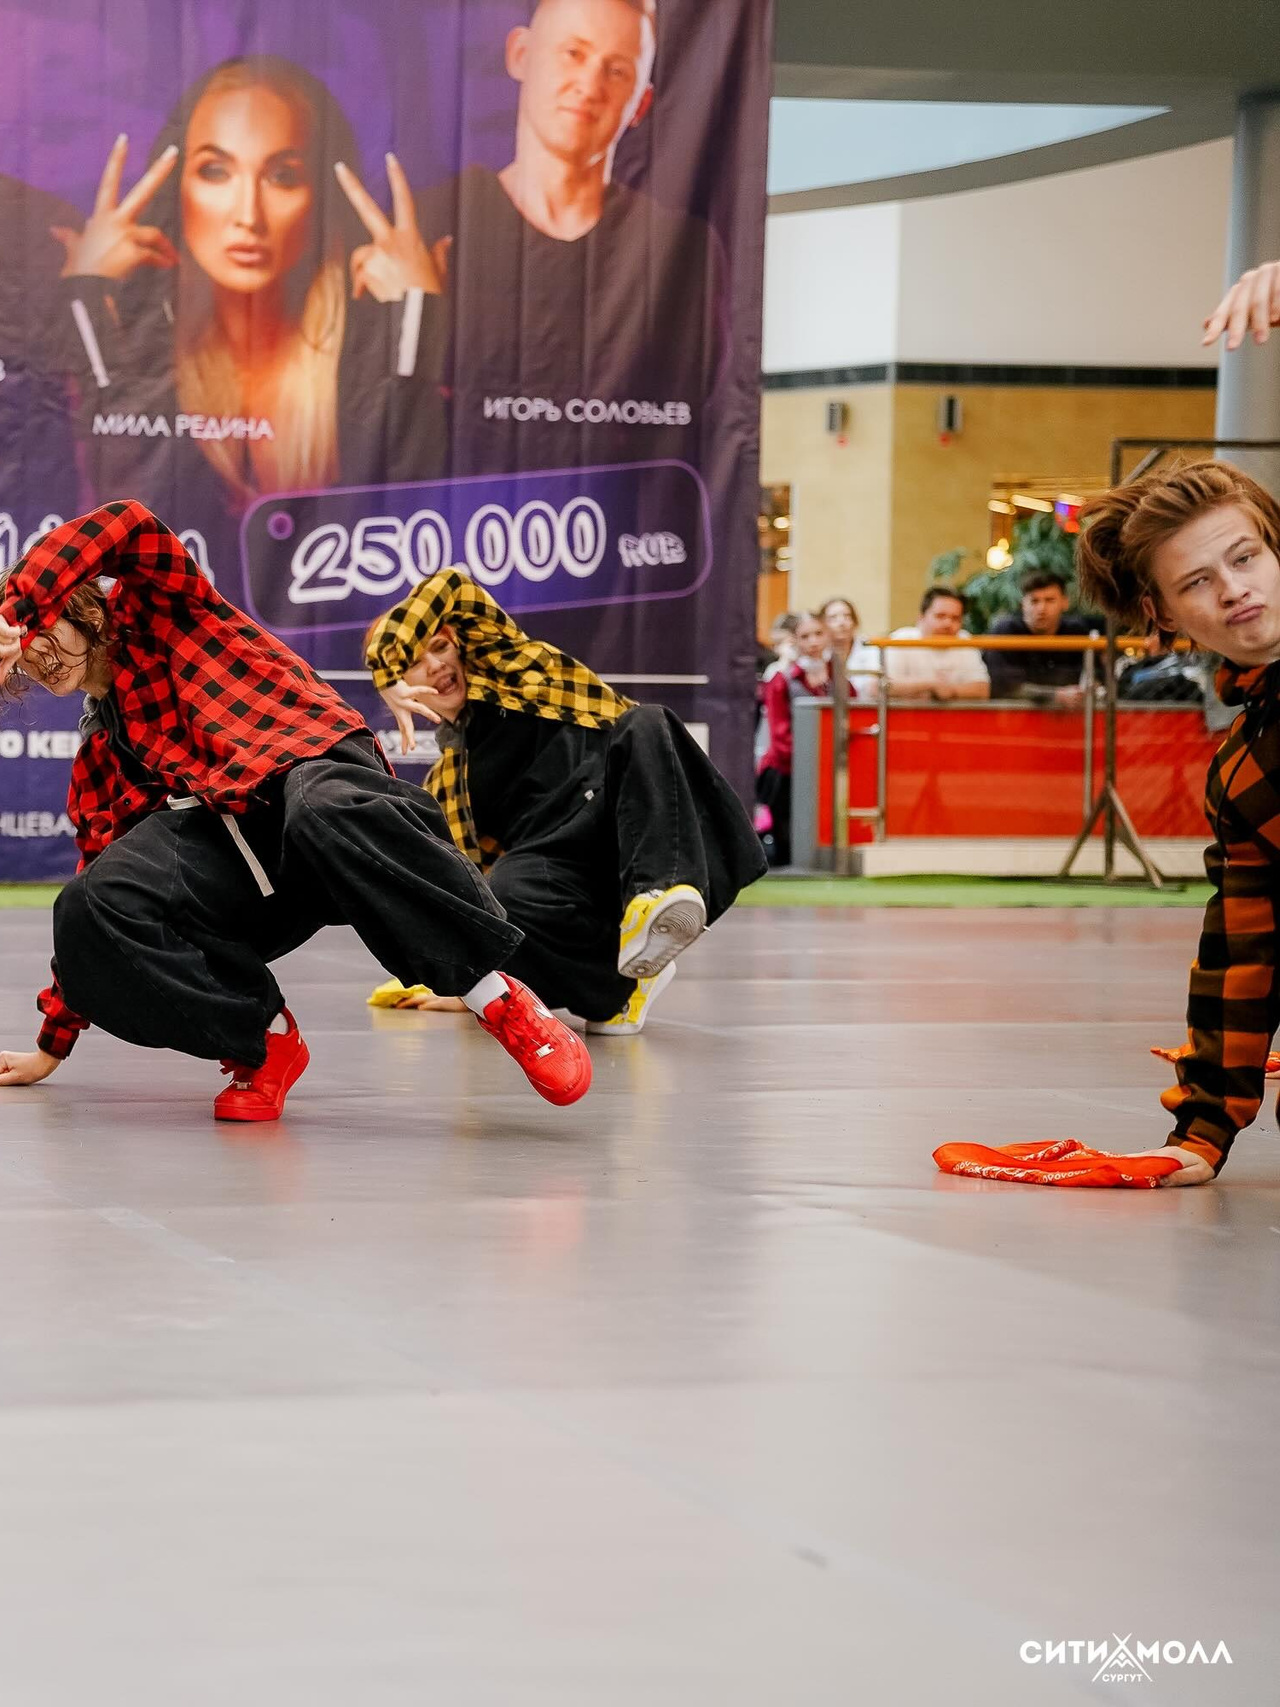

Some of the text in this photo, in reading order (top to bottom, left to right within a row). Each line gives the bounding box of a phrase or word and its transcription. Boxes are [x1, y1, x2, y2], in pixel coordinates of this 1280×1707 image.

[483, 396, 692, 425] ИГОРЬ СОЛОВЬЕВ
[92, 413, 276, 441] МИЛА РЕДИНА
